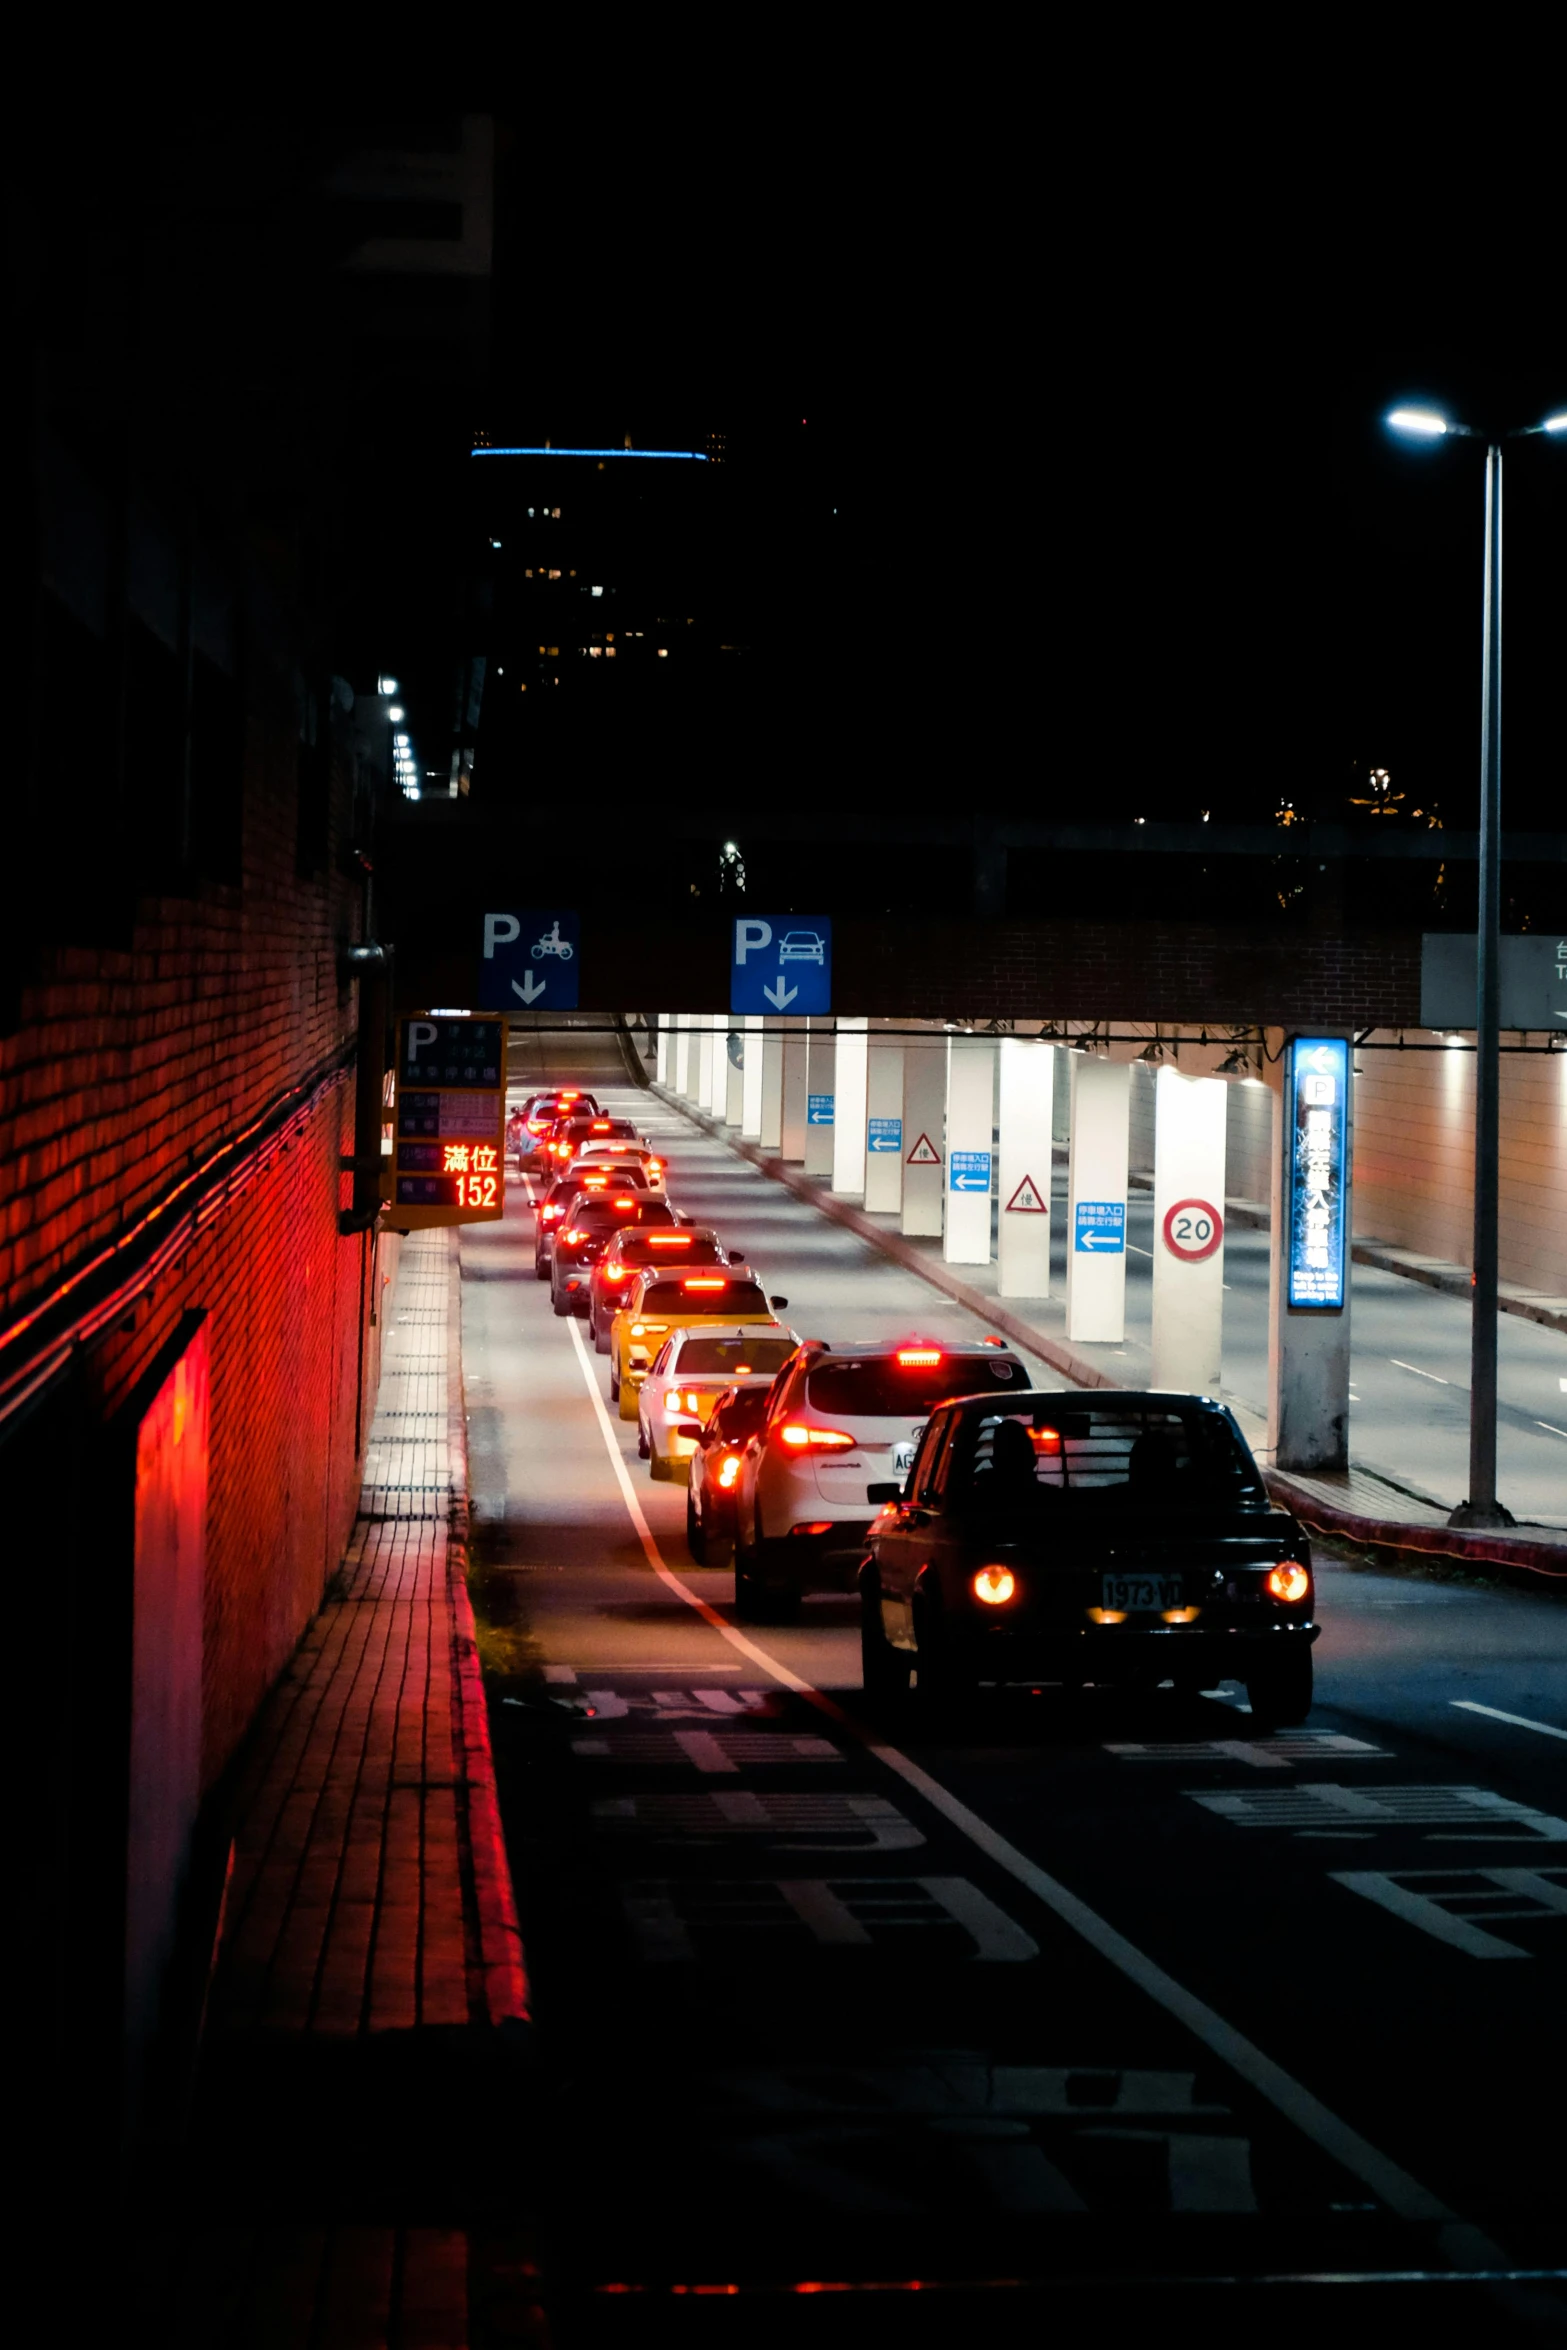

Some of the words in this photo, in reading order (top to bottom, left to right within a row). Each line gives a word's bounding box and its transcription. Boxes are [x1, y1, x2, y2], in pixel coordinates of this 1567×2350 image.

[484, 914, 520, 958] P
[736, 920, 772, 965] P
[407, 1021, 438, 1062] P
[1315, 1081, 1328, 1098] P
[443, 1144, 498, 1173] 滿位
[456, 1176, 497, 1206] 152
[1021, 1194, 1033, 1206] 慢
[1079, 1205, 1122, 1216] 停車場入口
[1175, 1218, 1211, 1240] 20
